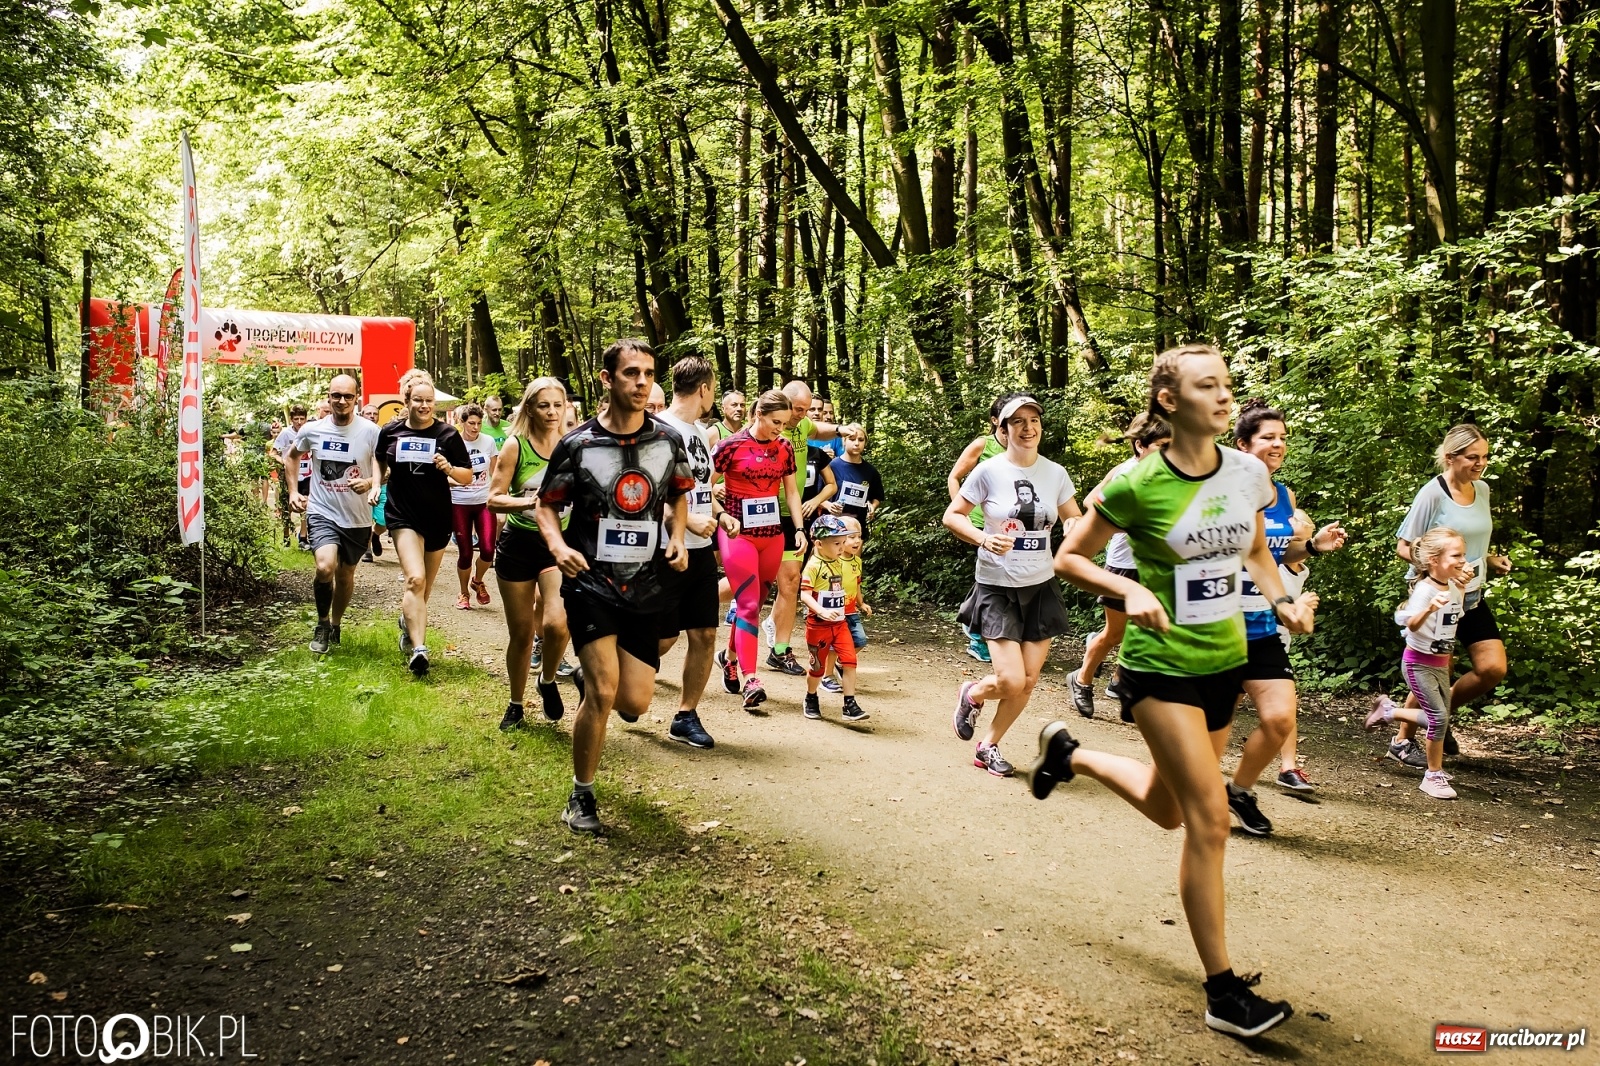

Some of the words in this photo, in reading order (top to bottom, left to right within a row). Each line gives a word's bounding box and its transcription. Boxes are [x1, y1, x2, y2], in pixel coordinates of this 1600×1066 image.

[329, 442, 342, 451] 52
[409, 442, 423, 451] 53
[701, 493, 711, 503] 44
[850, 489, 860, 497] 88
[756, 504, 768, 514] 81
[617, 531, 638, 545] 18
[1023, 539, 1039, 550] 59
[1202, 577, 1229, 598] 36
